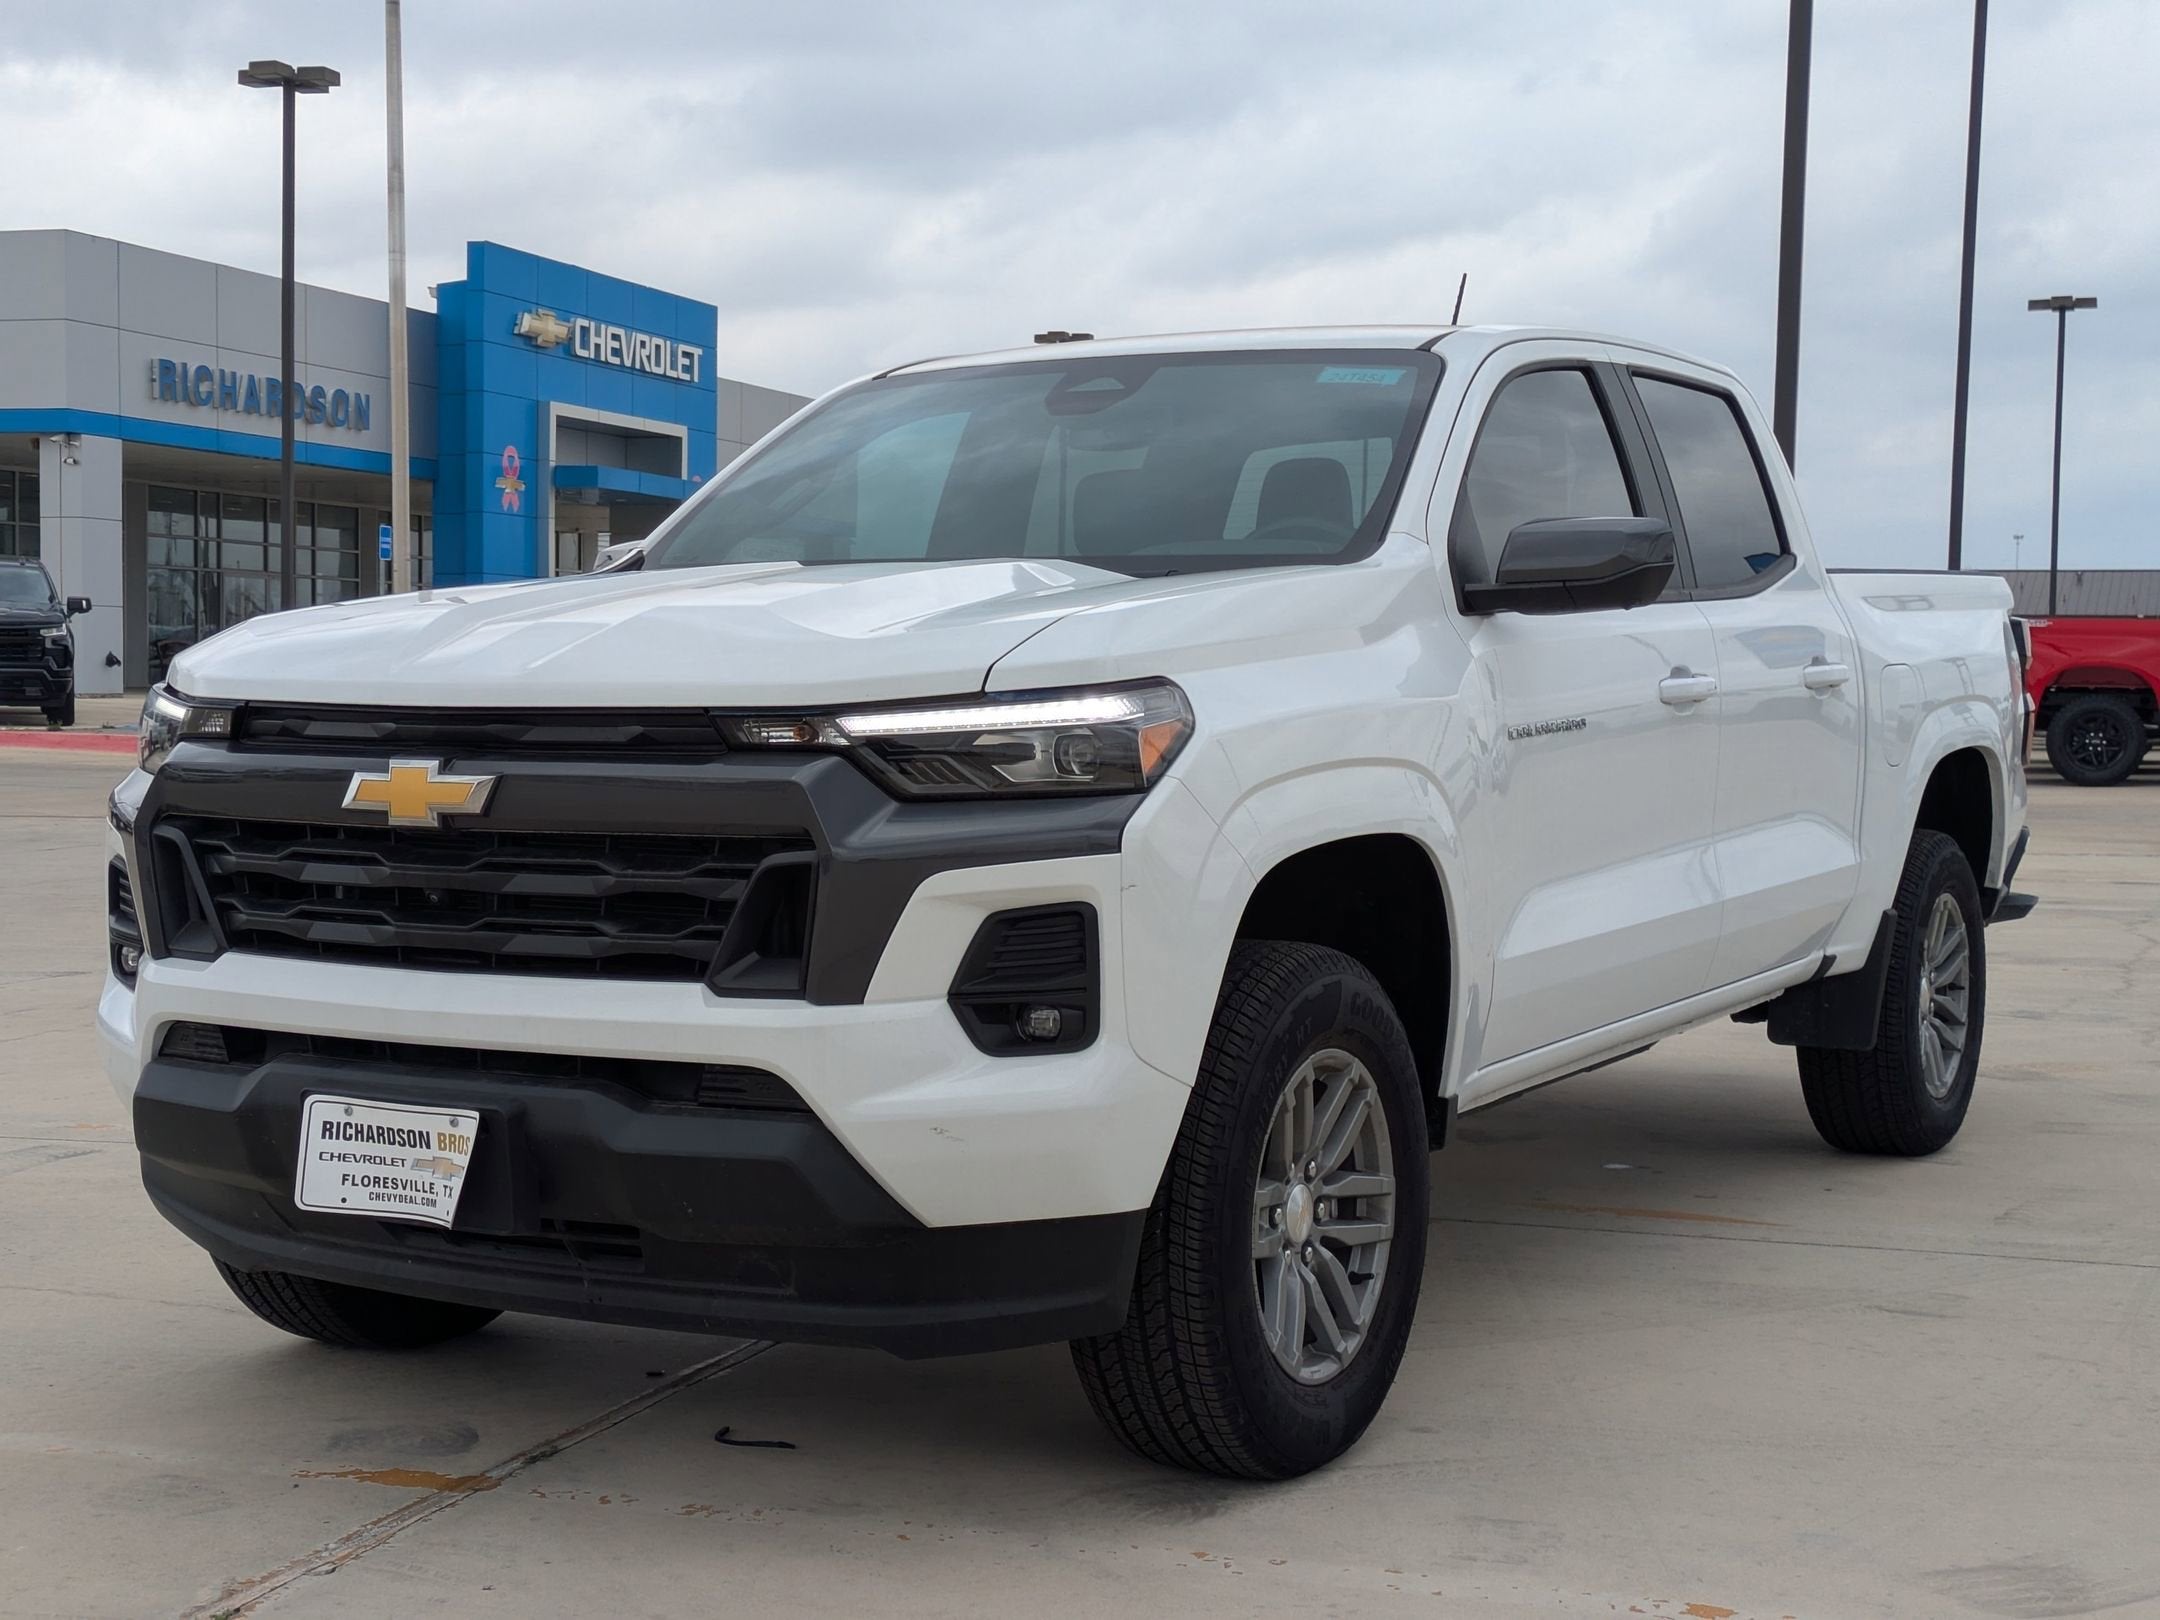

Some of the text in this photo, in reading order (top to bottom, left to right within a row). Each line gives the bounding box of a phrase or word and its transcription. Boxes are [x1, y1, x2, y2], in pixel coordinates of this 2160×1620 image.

[573, 317, 703, 383] CHEVROLET
[152, 358, 370, 431] RICHARDSON
[320, 1121, 471, 1157] RICHARDSON BROS
[319, 1151, 407, 1168] CHEVROLET
[341, 1174, 454, 1199] FLORESVILLE, TX
[368, 1191, 437, 1208] CHEVYDEAL.COM
